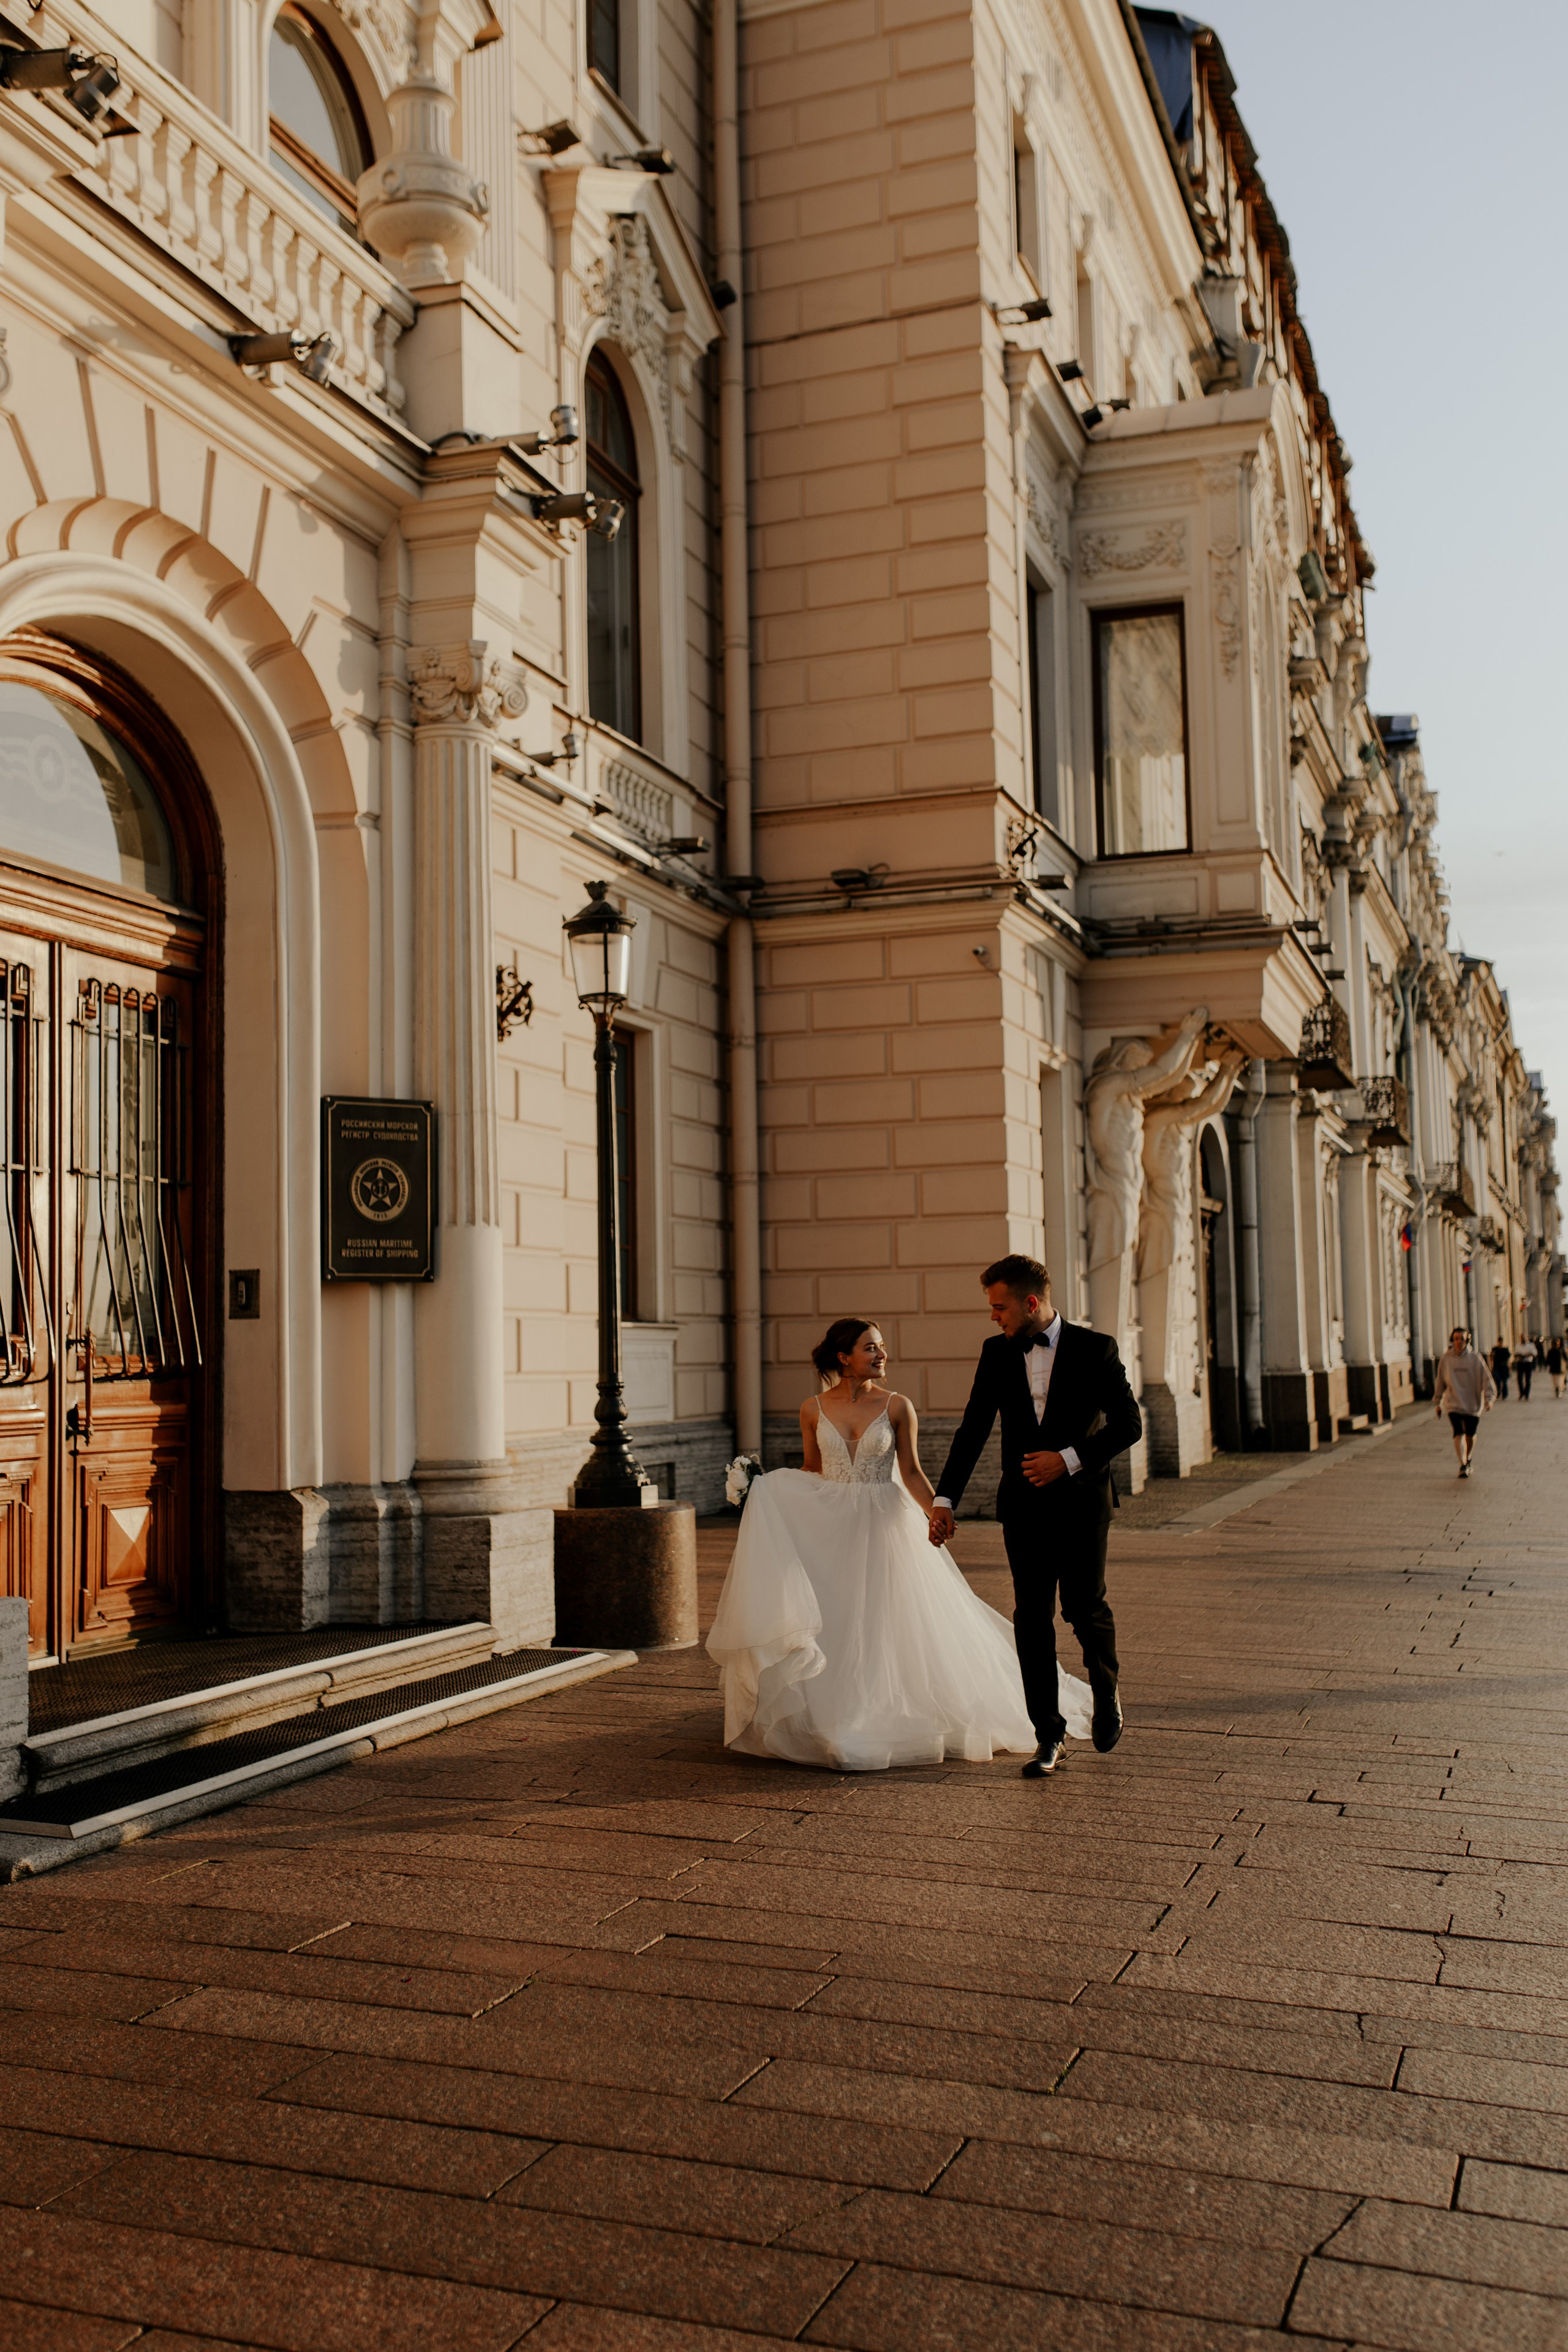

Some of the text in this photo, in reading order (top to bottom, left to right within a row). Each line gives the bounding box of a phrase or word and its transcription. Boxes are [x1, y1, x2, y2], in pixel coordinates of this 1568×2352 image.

[341, 1118, 418, 1130] РОССИЙСКИЙ МОРСКОЙ
[341, 1130, 418, 1141] РЕГИСТР СУДОХОДСТВА
[347, 1238, 413, 1248] RUSSIAN MARITIME
[342, 1248, 418, 1259] REGISTER OF SHIPPING
